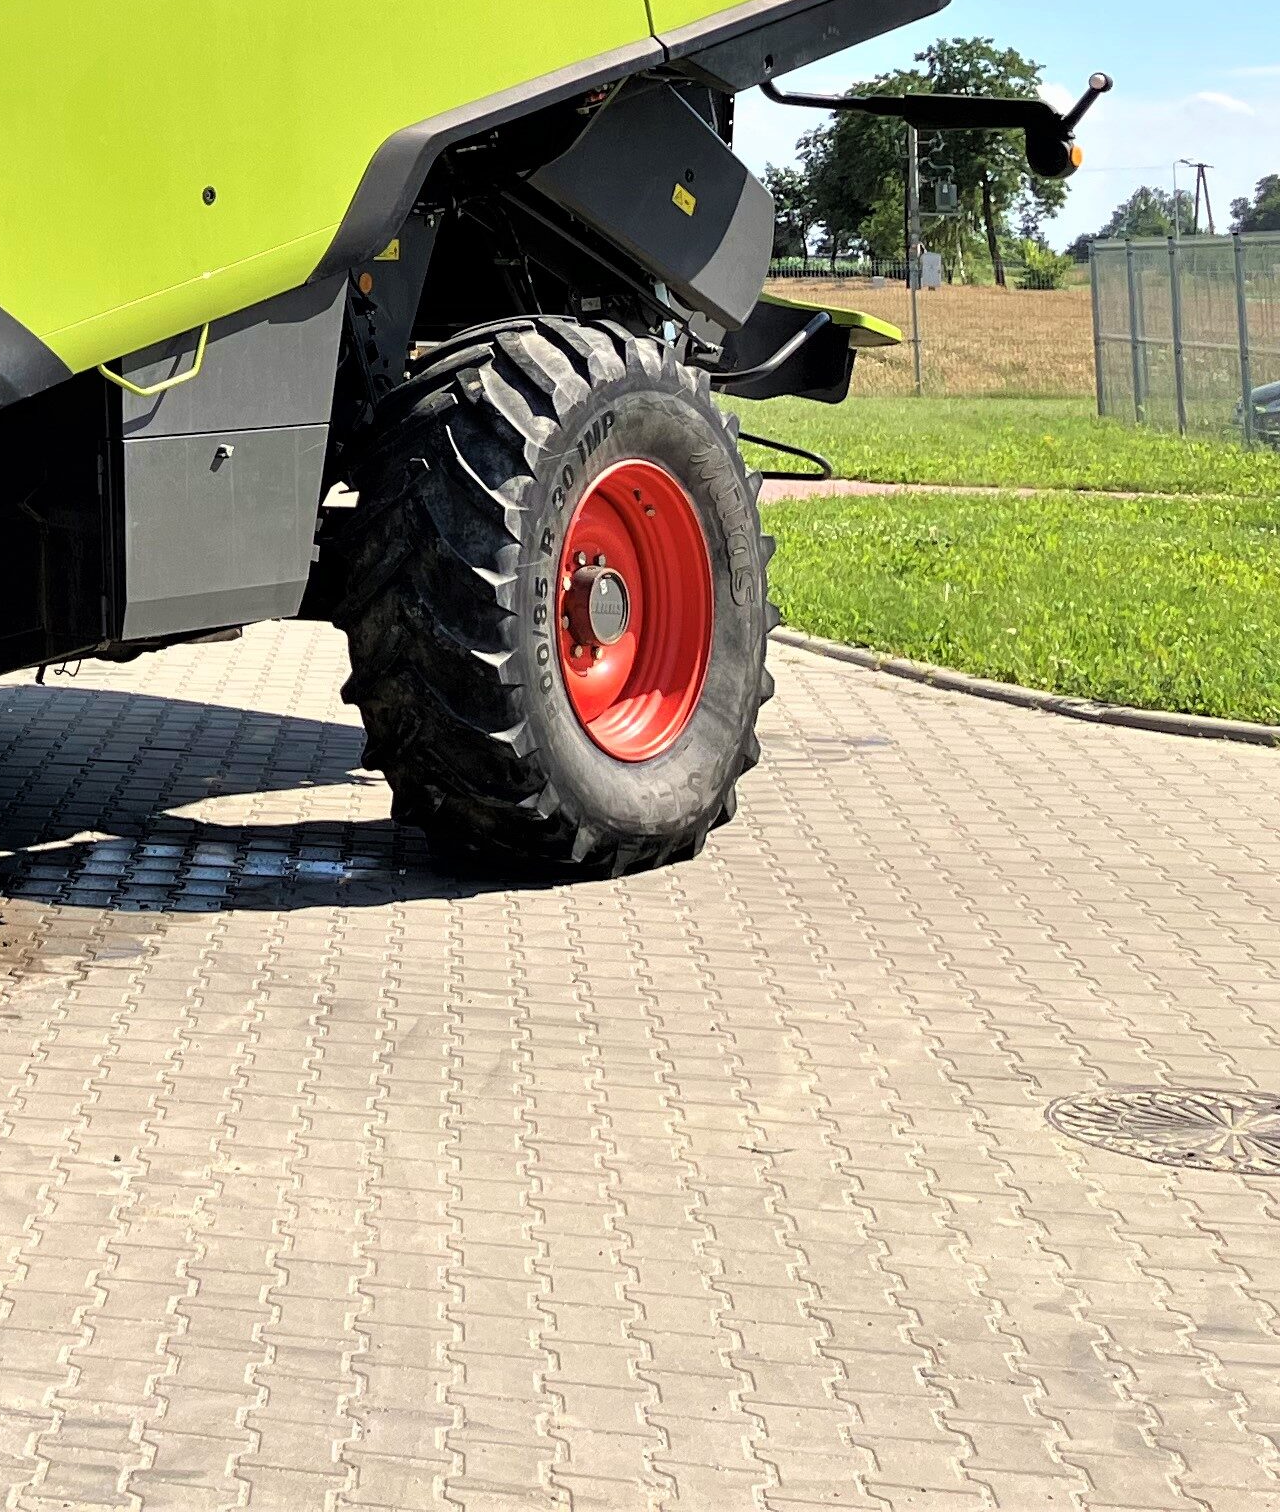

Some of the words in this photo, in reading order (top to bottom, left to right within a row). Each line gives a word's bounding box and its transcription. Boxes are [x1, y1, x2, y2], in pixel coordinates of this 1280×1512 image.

[540, 526, 557, 558] R
[550, 462, 576, 513] 30
[575, 408, 617, 467] IMP
